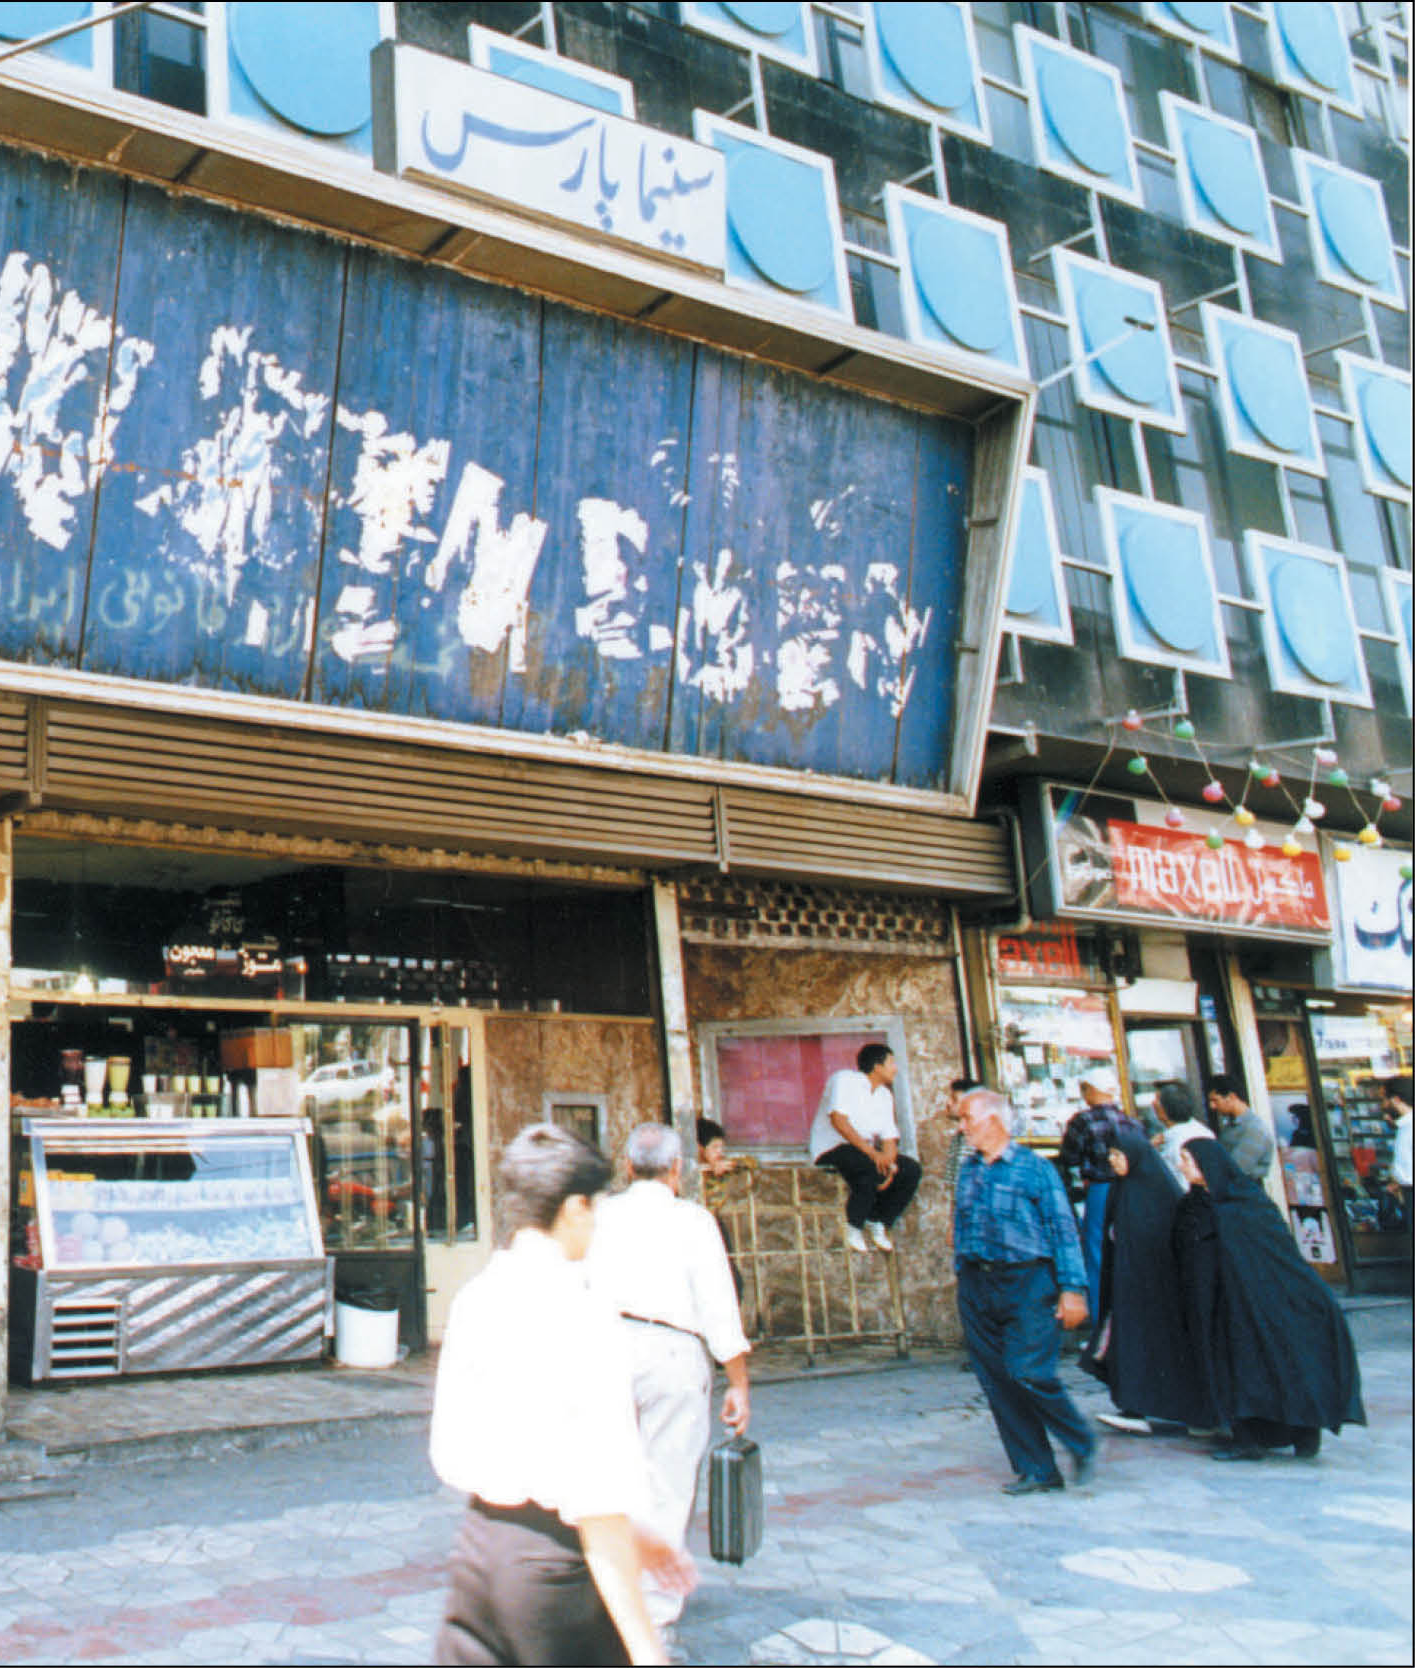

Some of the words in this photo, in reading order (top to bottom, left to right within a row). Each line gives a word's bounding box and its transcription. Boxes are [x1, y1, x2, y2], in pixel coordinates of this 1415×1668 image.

[422, 110, 620, 232] پارس
[639, 142, 714, 250] سینما
[1128, 845, 1243, 903] maxell
